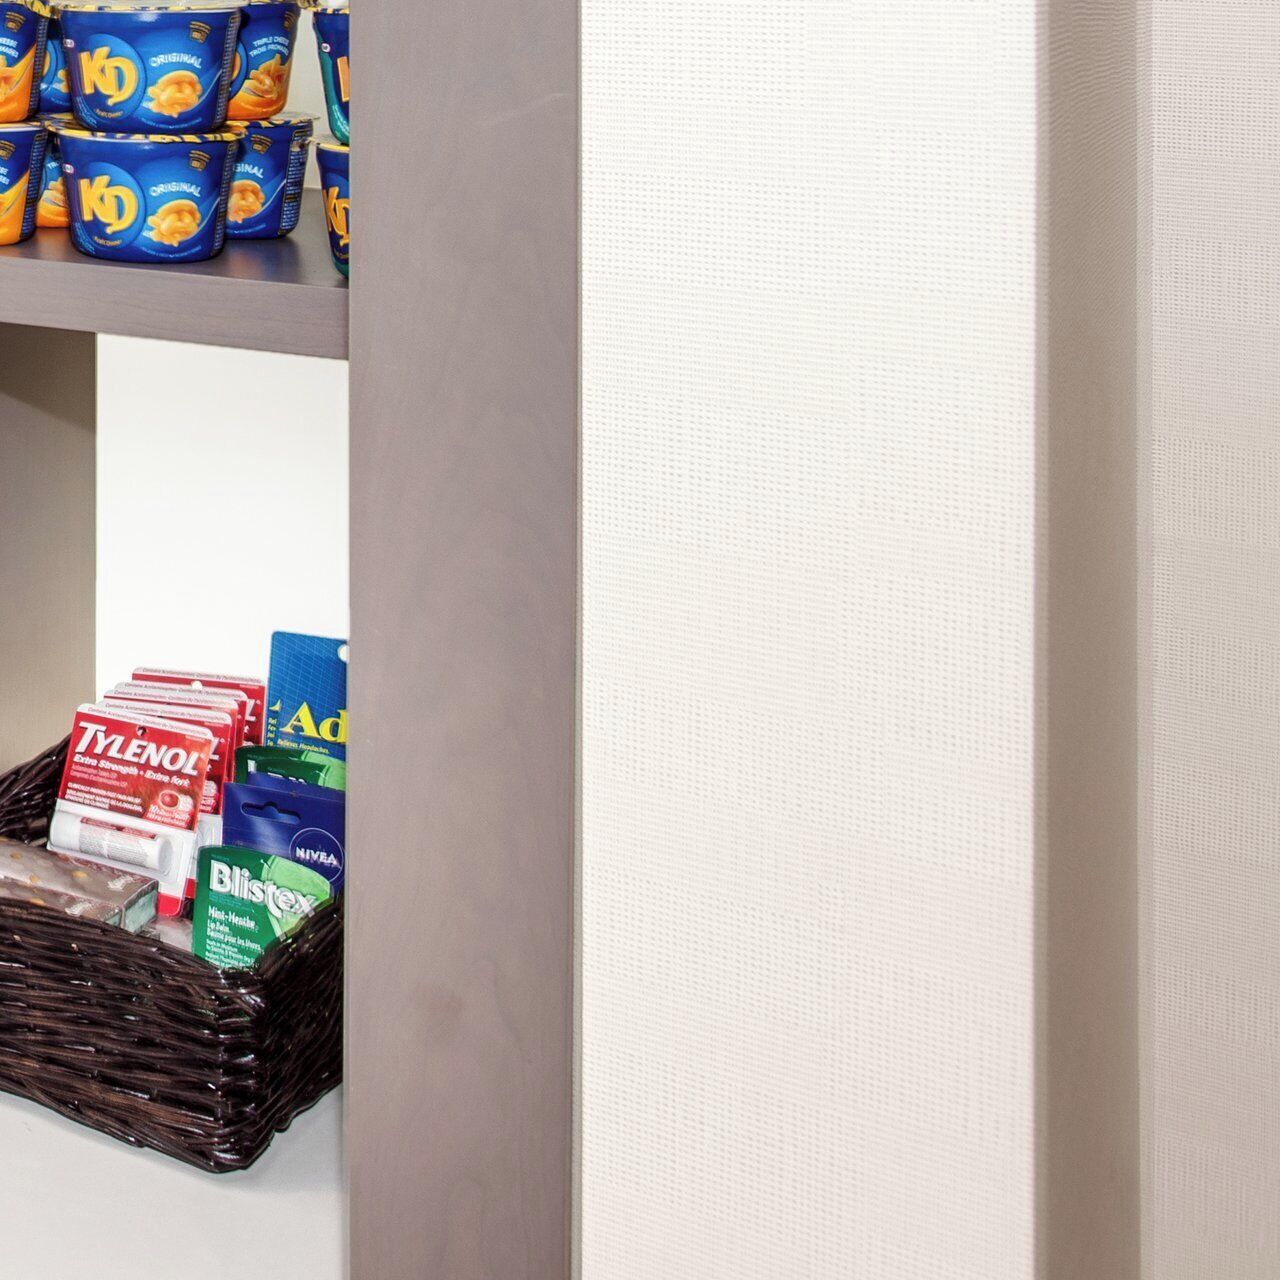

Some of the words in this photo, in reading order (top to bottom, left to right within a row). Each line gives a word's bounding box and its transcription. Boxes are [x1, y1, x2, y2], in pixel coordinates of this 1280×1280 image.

[78, 45, 139, 108] KD
[148, 52, 202, 69] ORIGINAL
[78, 174, 140, 235] KD
[148, 182, 201, 198] ORIGINAL
[73, 753, 98, 767] Extra
[98, 758, 140, 776] Strength
[144, 769, 170, 784] Extra
[171, 775, 192, 788] fort
[75, 721, 203, 776] TYLENOL
[295, 847, 338, 867] NIVEA
[209, 859, 317, 919] Blistex
